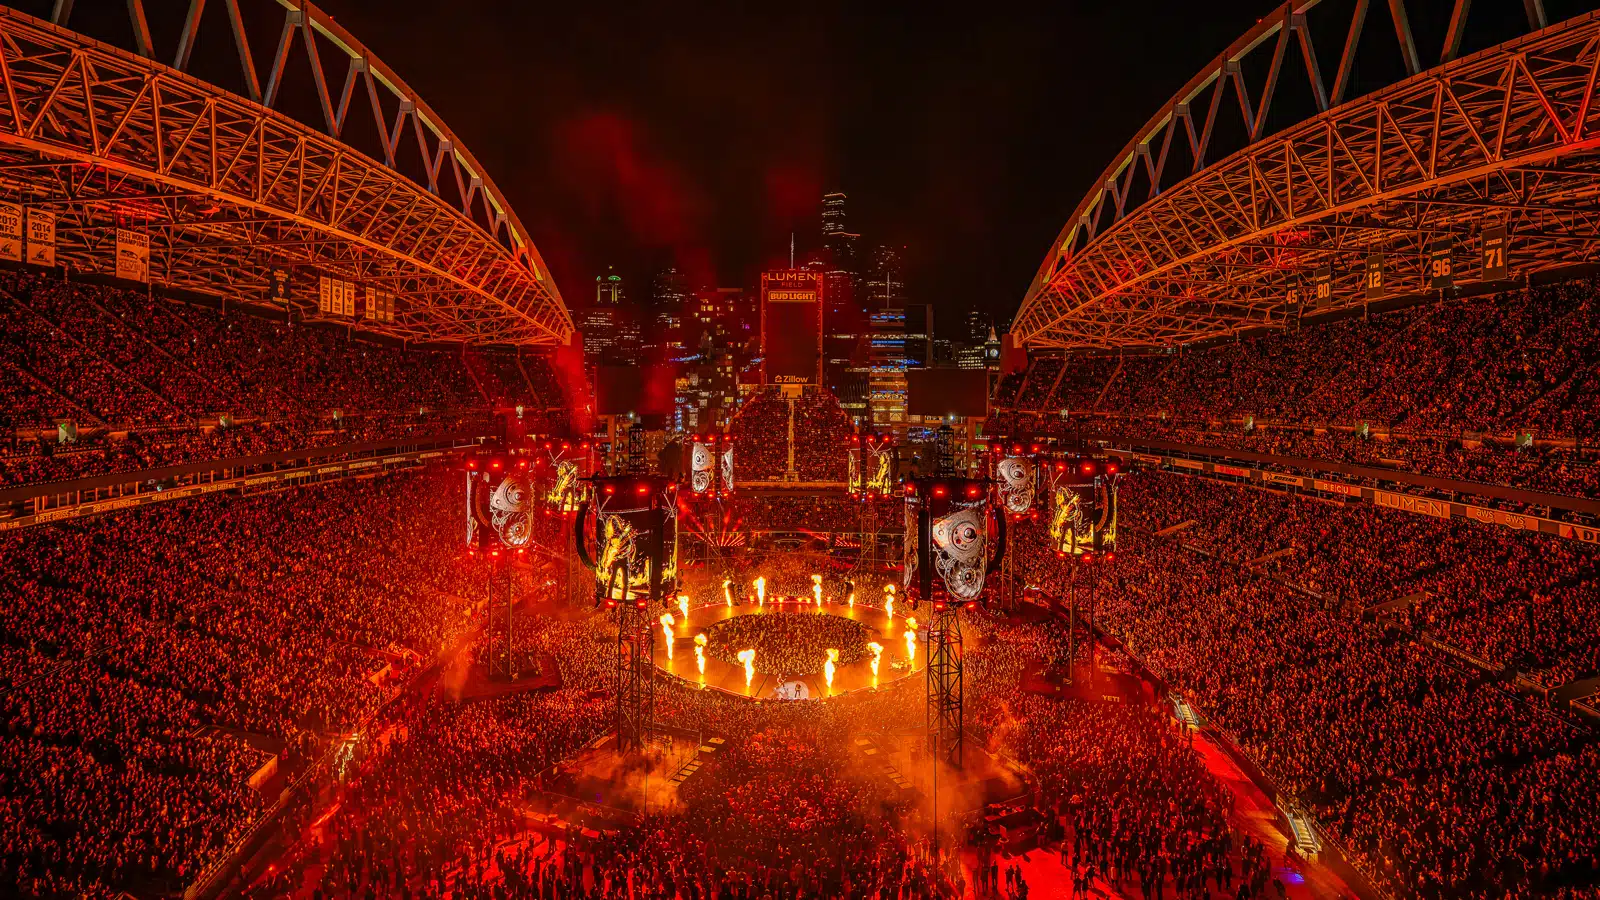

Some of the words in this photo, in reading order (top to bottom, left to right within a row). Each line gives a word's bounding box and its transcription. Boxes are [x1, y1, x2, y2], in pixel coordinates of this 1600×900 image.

[31, 222, 51, 233] 2014
[34, 231, 49, 240] NFC
[1485, 247, 1504, 269] 71
[1432, 257, 1451, 278] 96
[768, 272, 817, 281] LUMEN
[1368, 271, 1381, 289] 12
[1286, 289, 1298, 304] 45
[1317, 283, 1330, 299] 80
[783, 375, 809, 383] Zillow
[1273, 475, 1298, 483] BOEING
[1380, 491, 1445, 517] LUMEN
[1476, 508, 1494, 519] aws
[1505, 514, 1526, 525] aws
